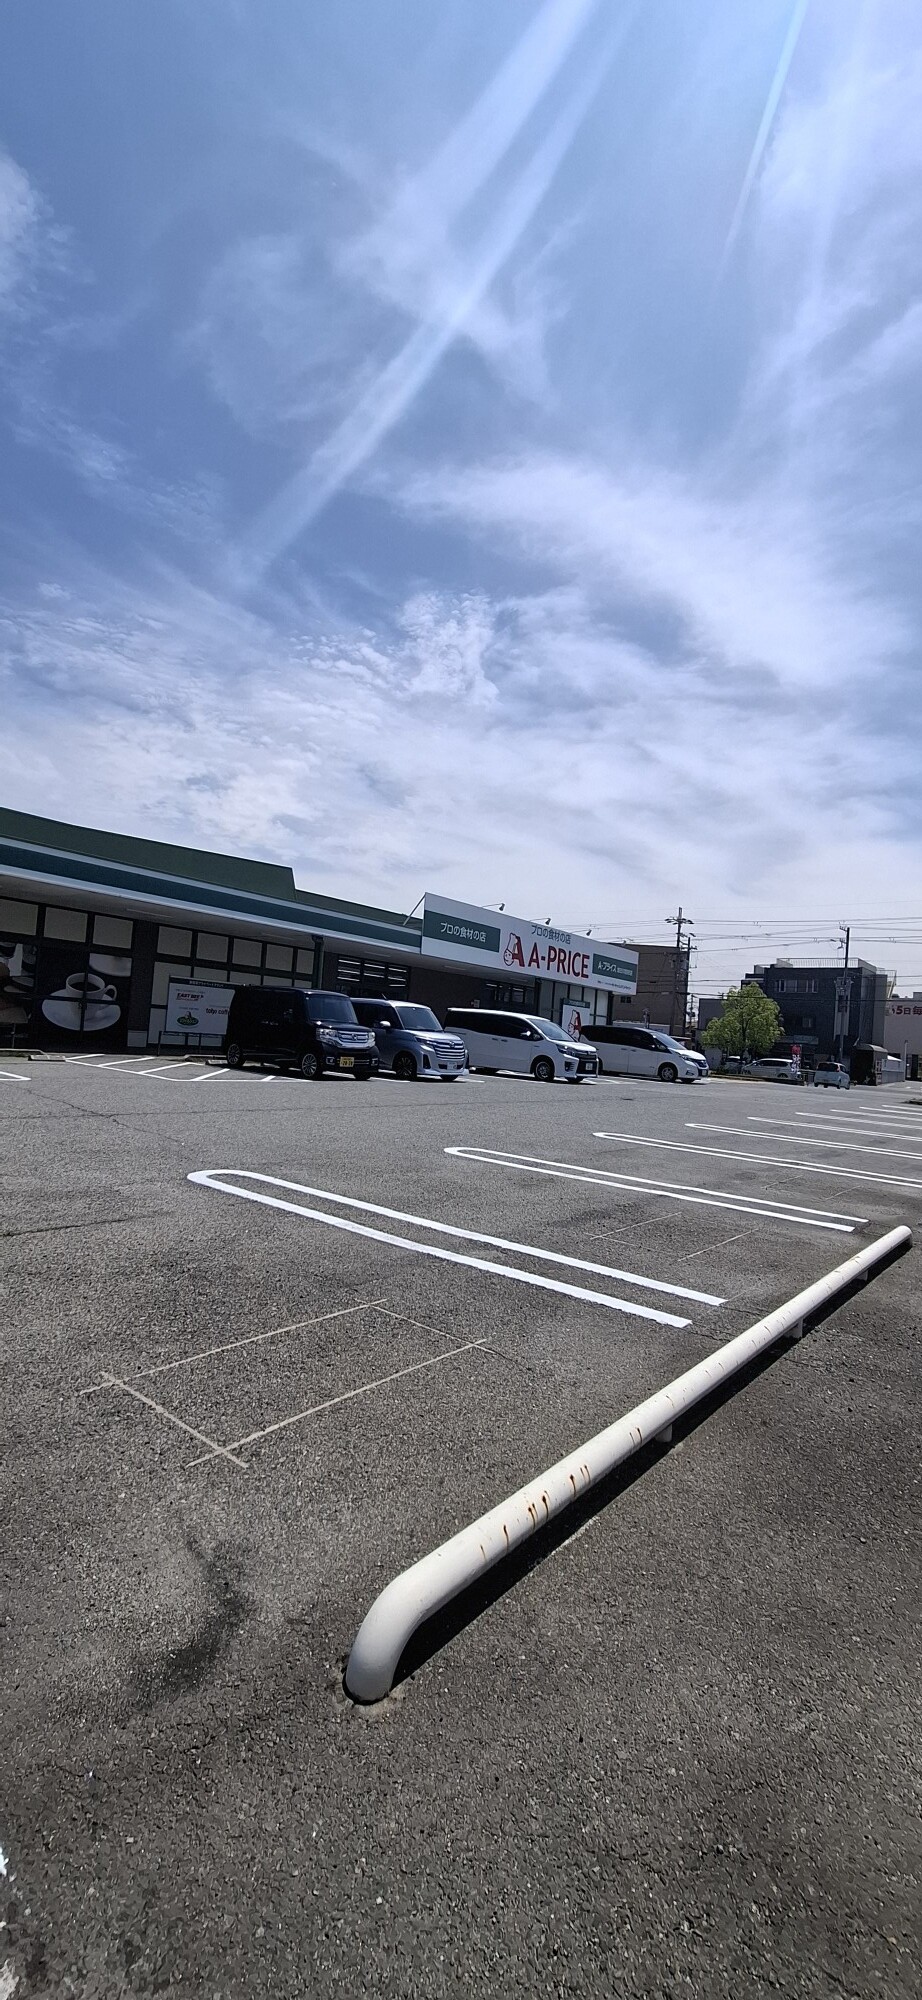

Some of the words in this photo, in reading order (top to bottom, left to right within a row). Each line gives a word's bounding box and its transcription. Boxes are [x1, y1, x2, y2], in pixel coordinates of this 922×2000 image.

[440, 921, 487, 943] プロの食材の店
[531, 924, 572, 945] プロの食材の店
[528, 942, 590, 978] A-PRICE
